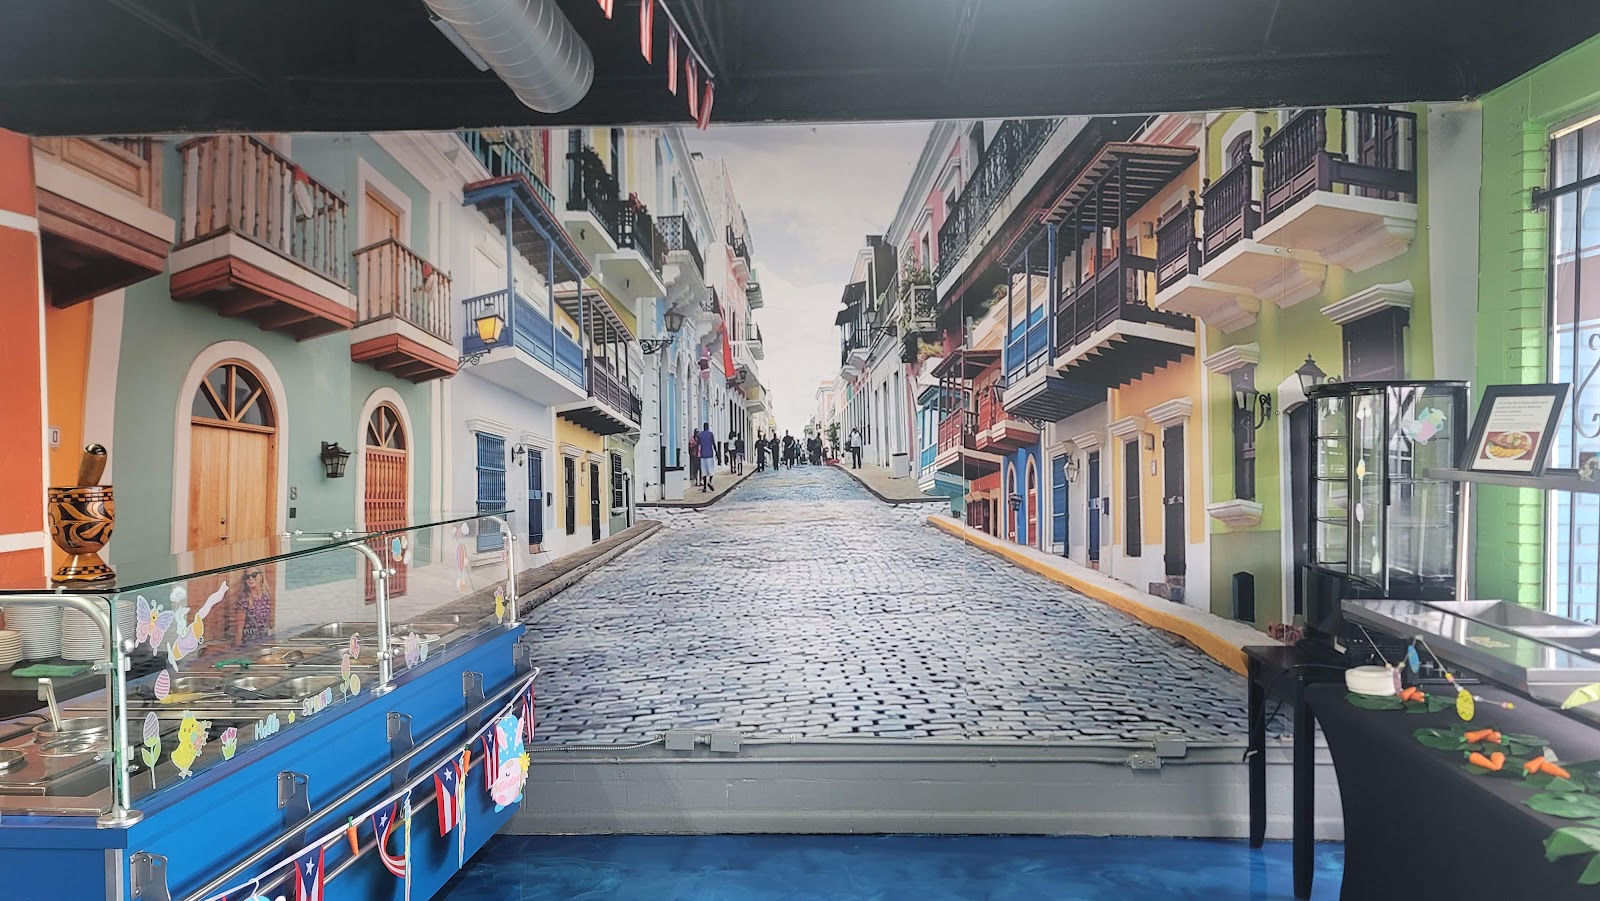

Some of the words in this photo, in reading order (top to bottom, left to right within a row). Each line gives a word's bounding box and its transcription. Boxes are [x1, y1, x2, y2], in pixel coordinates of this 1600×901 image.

[290, 486, 297, 501] 8
[254, 712, 280, 741] Hello
[302, 687, 333, 717] SPRING
